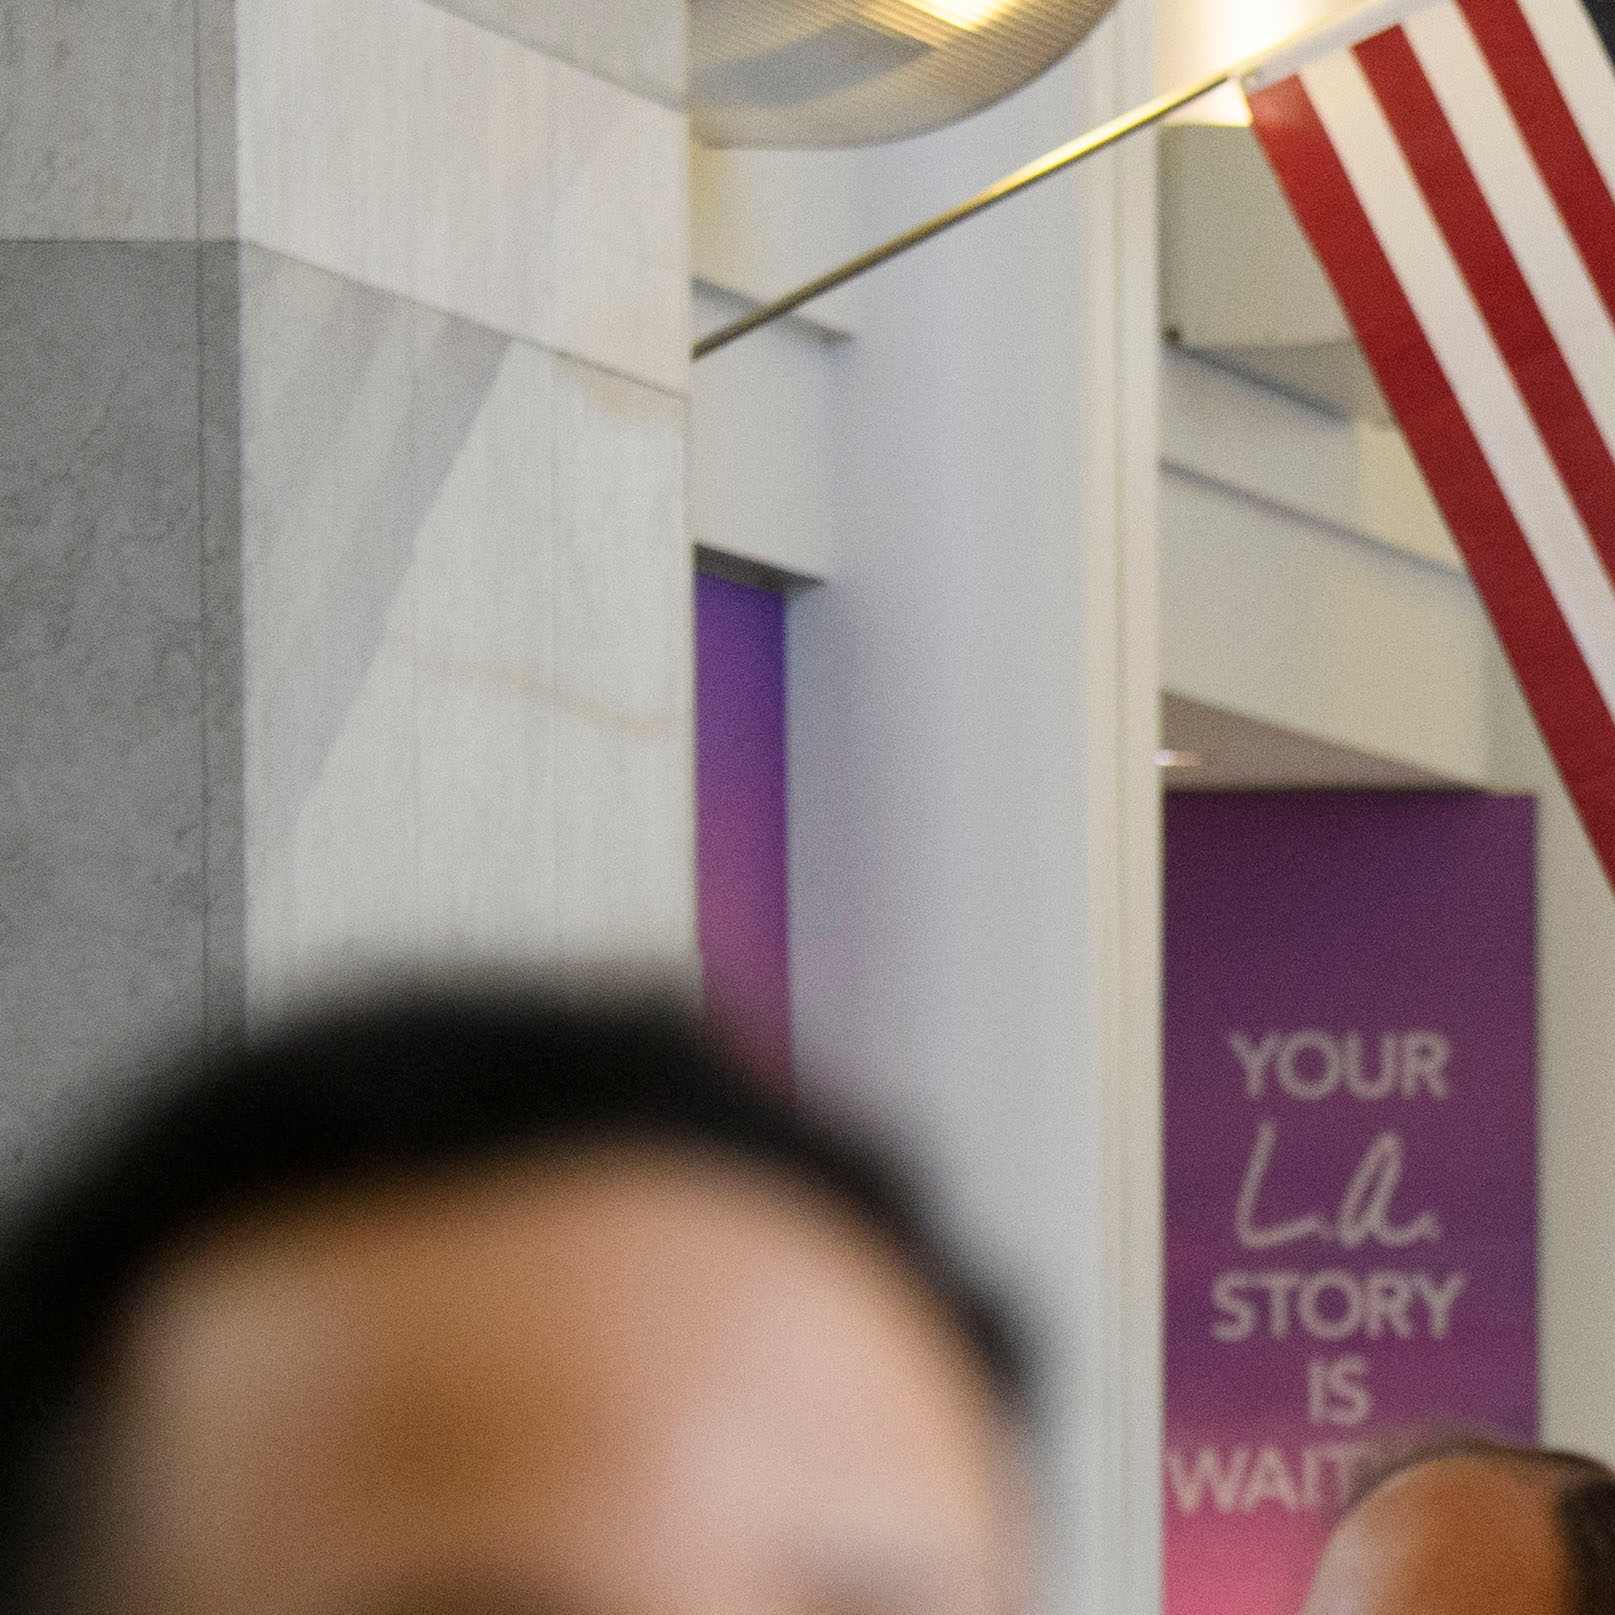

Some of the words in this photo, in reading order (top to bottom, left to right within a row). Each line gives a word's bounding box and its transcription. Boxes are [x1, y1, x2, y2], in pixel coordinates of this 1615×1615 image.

[1228, 1030, 1451, 1100] YOUR
[1211, 1270, 1467, 1341] STORY
[1307, 1354, 1373, 1427] IS
